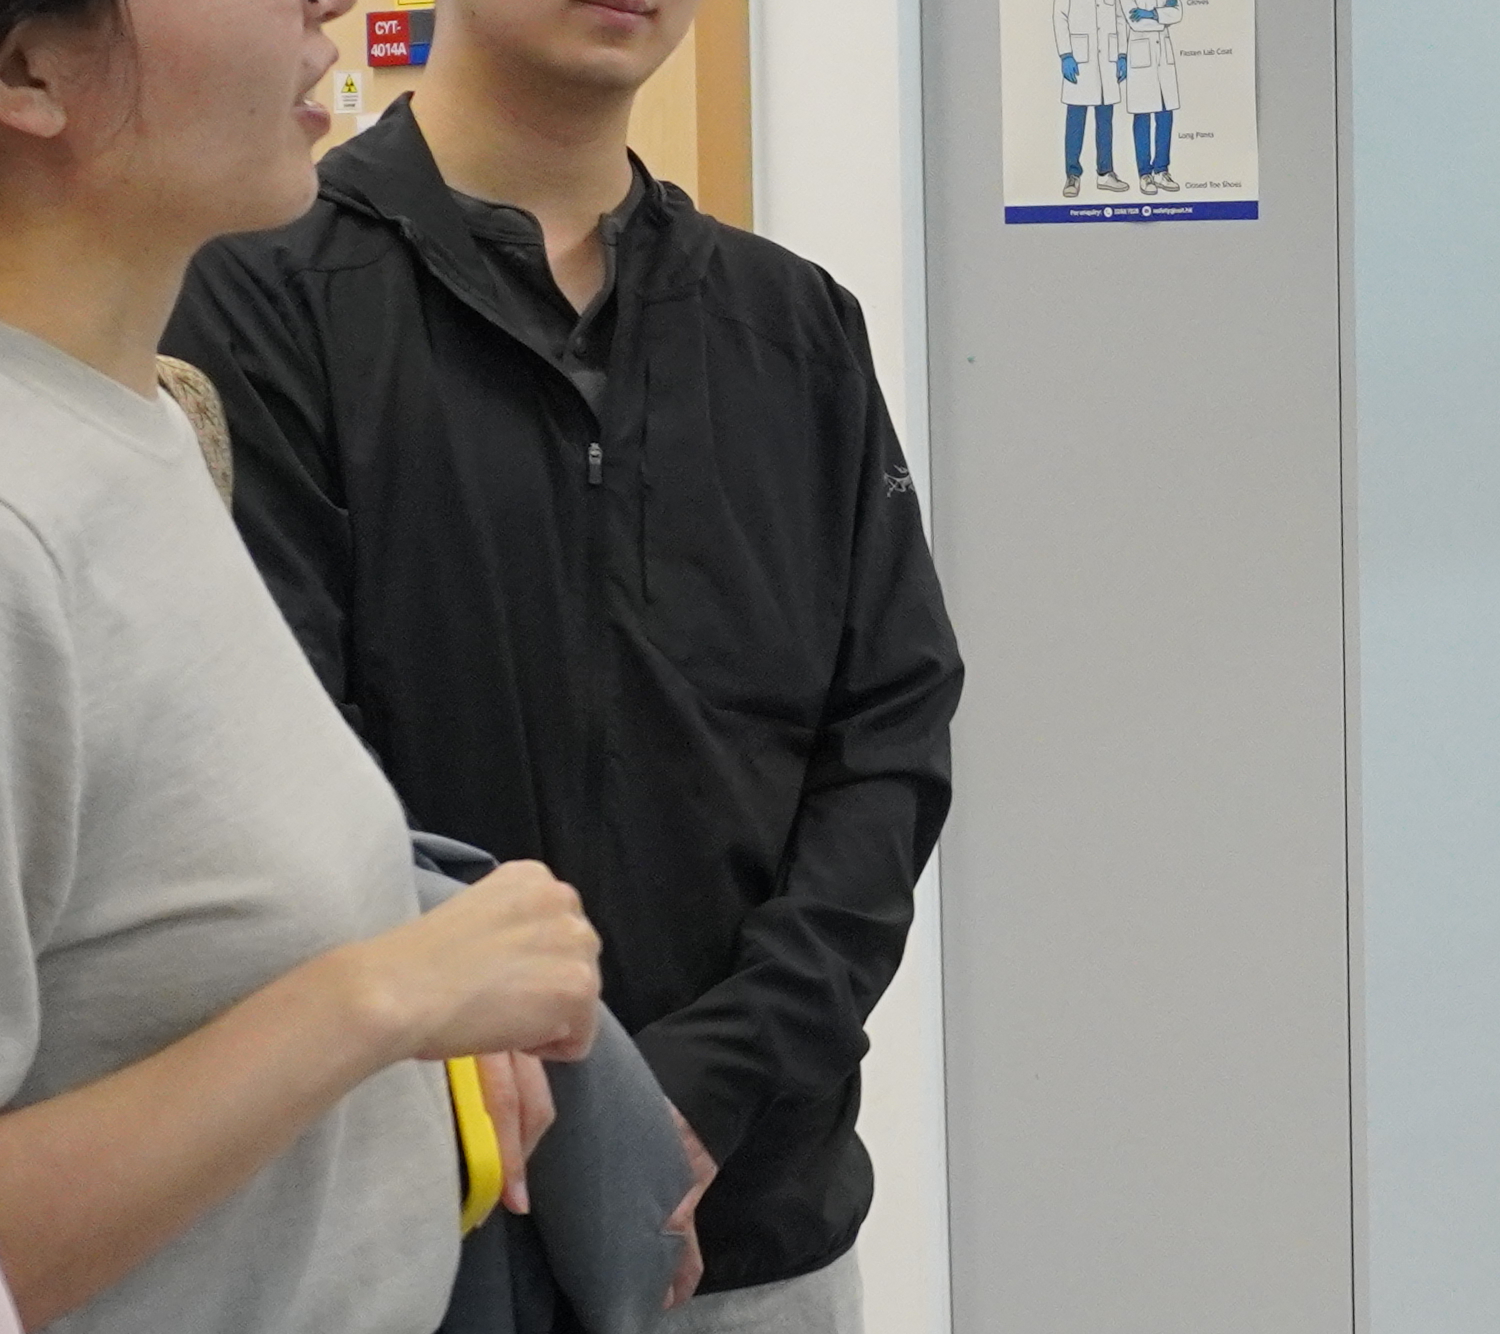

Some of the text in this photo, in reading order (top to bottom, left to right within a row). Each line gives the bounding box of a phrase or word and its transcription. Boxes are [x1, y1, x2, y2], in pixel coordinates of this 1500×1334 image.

[374, 20, 402, 35] CYT-
[370, 42, 407, 57] 4014A
[1180, 47, 1233, 57] Fasten Lab Coat
[1178, 130, 1214, 140] Long Pants
[1185, 180, 1242, 189] Closed Toe Shoes
